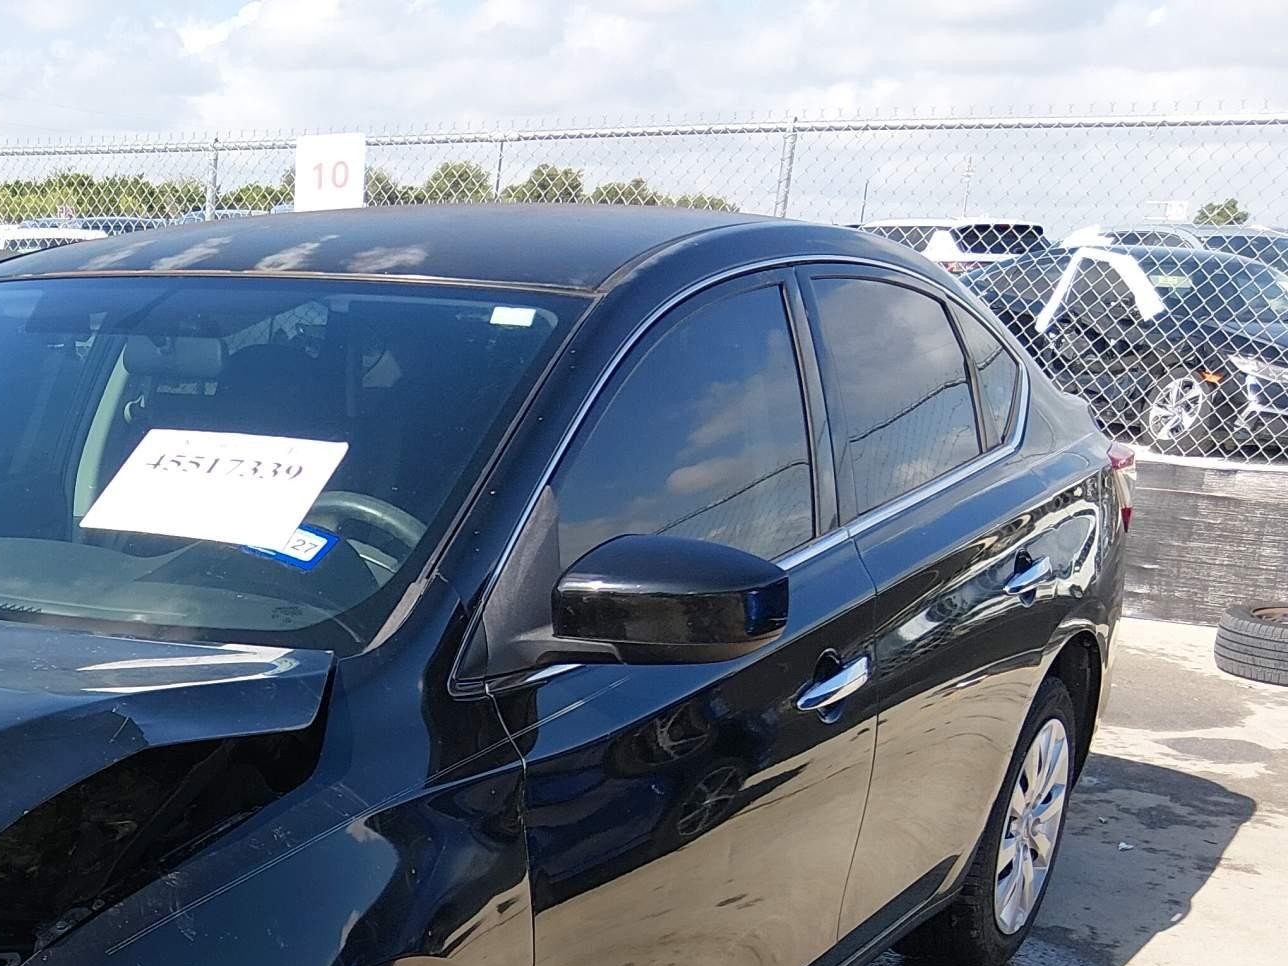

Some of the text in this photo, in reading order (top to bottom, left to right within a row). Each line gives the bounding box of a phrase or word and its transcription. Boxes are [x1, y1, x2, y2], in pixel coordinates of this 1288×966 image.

[313, 160, 349, 191] 10
[146, 454, 304, 480] 45517339
[290, 538, 318, 554] 27
